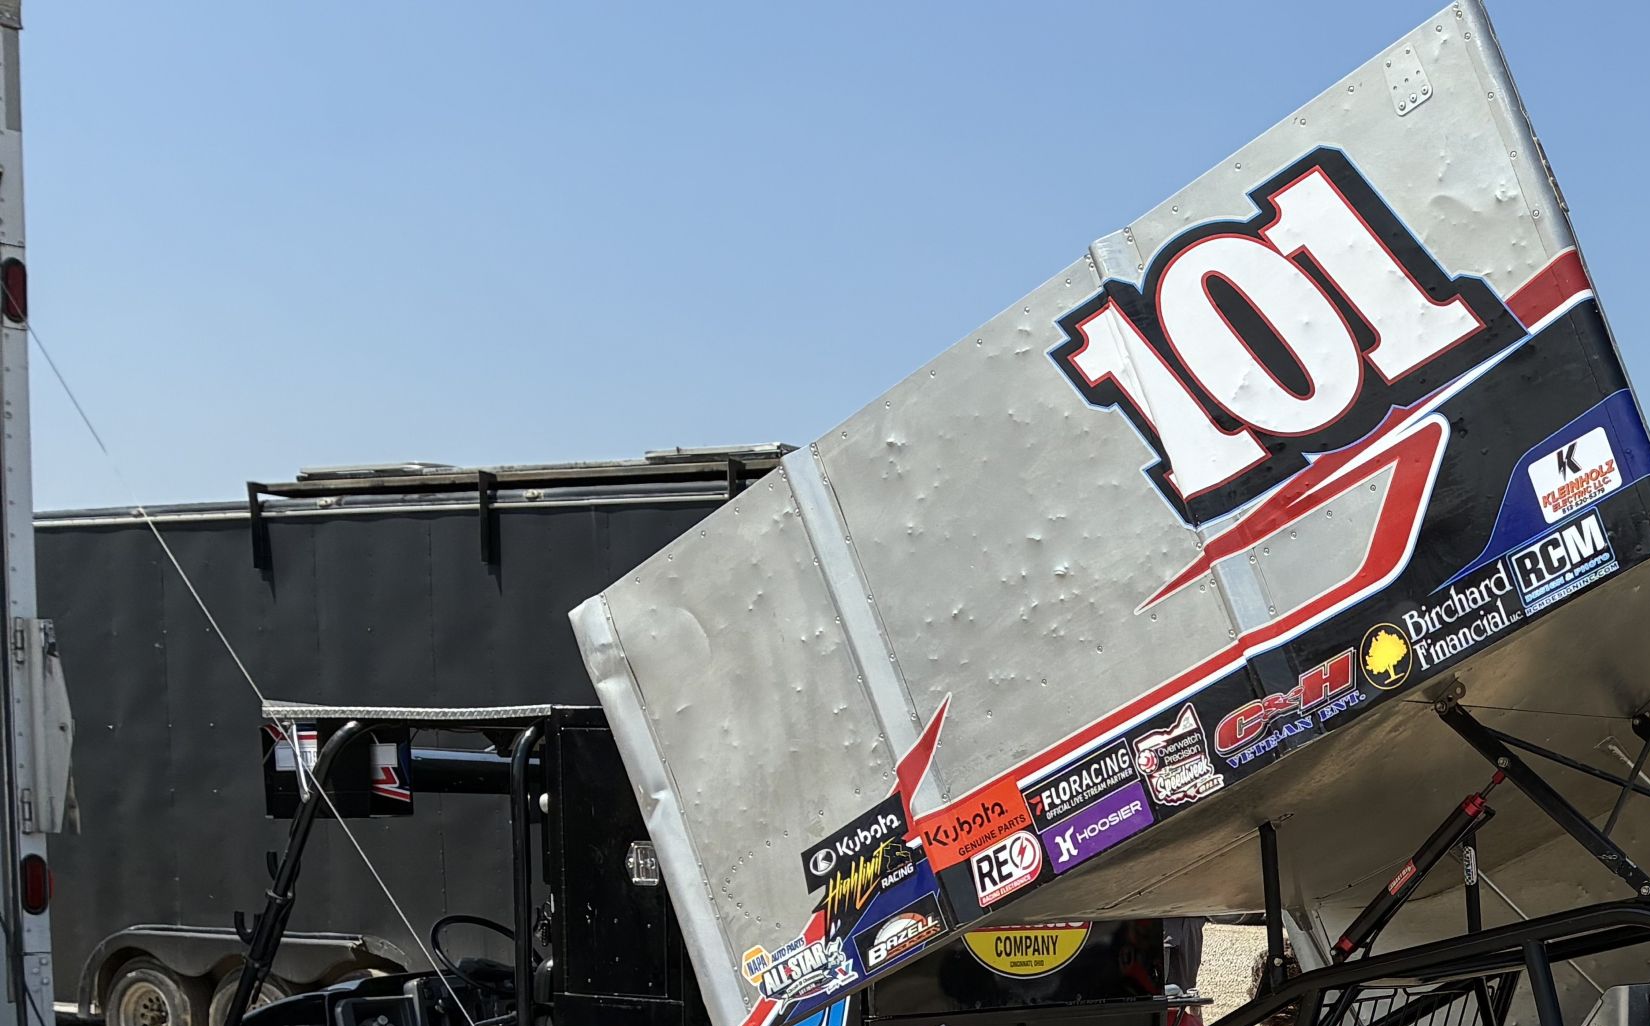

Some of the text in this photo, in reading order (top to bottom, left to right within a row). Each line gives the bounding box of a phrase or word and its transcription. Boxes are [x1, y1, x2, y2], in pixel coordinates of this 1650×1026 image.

[1067, 165, 1486, 500] 101
[1541, 459, 1616, 509] KLEINHOLZ
[1552, 487, 1593, 513] ELECTRIC
[1514, 514, 1608, 594] RCM
[1573, 552, 1611, 578] PHOTO
[1402, 559, 1513, 643] Birchard
[1525, 560, 1620, 617] RCMDESIGNINC.COM
[1413, 597, 1511, 671] Financial
[1215, 646, 1357, 758] C&H
[1158, 732, 1202, 757] Overwatch
[1226, 690, 1367, 769] VETERAN ENT.
[1157, 757, 1210, 799] Speedweek
[1164, 743, 1201, 765] Precision
[1041, 749, 1131, 812] FLORACING
[1046, 766, 1133, 820] OFFICIAL LIVE STREAM PARTNER
[836, 814, 901, 857] Kubota
[924, 801, 1007, 847] Kubota
[958, 814, 1026, 857] GENUINE PARTS
[1076, 800, 1143, 844] HOOSIER
[881, 862, 914, 890] RACING
[747, 938, 805, 977] NAPA AUTO PARTS
[869, 915, 939, 967] BAZELL
[994, 935, 1059, 958] COMPANY
[762, 945, 828, 997] ALL STAR
